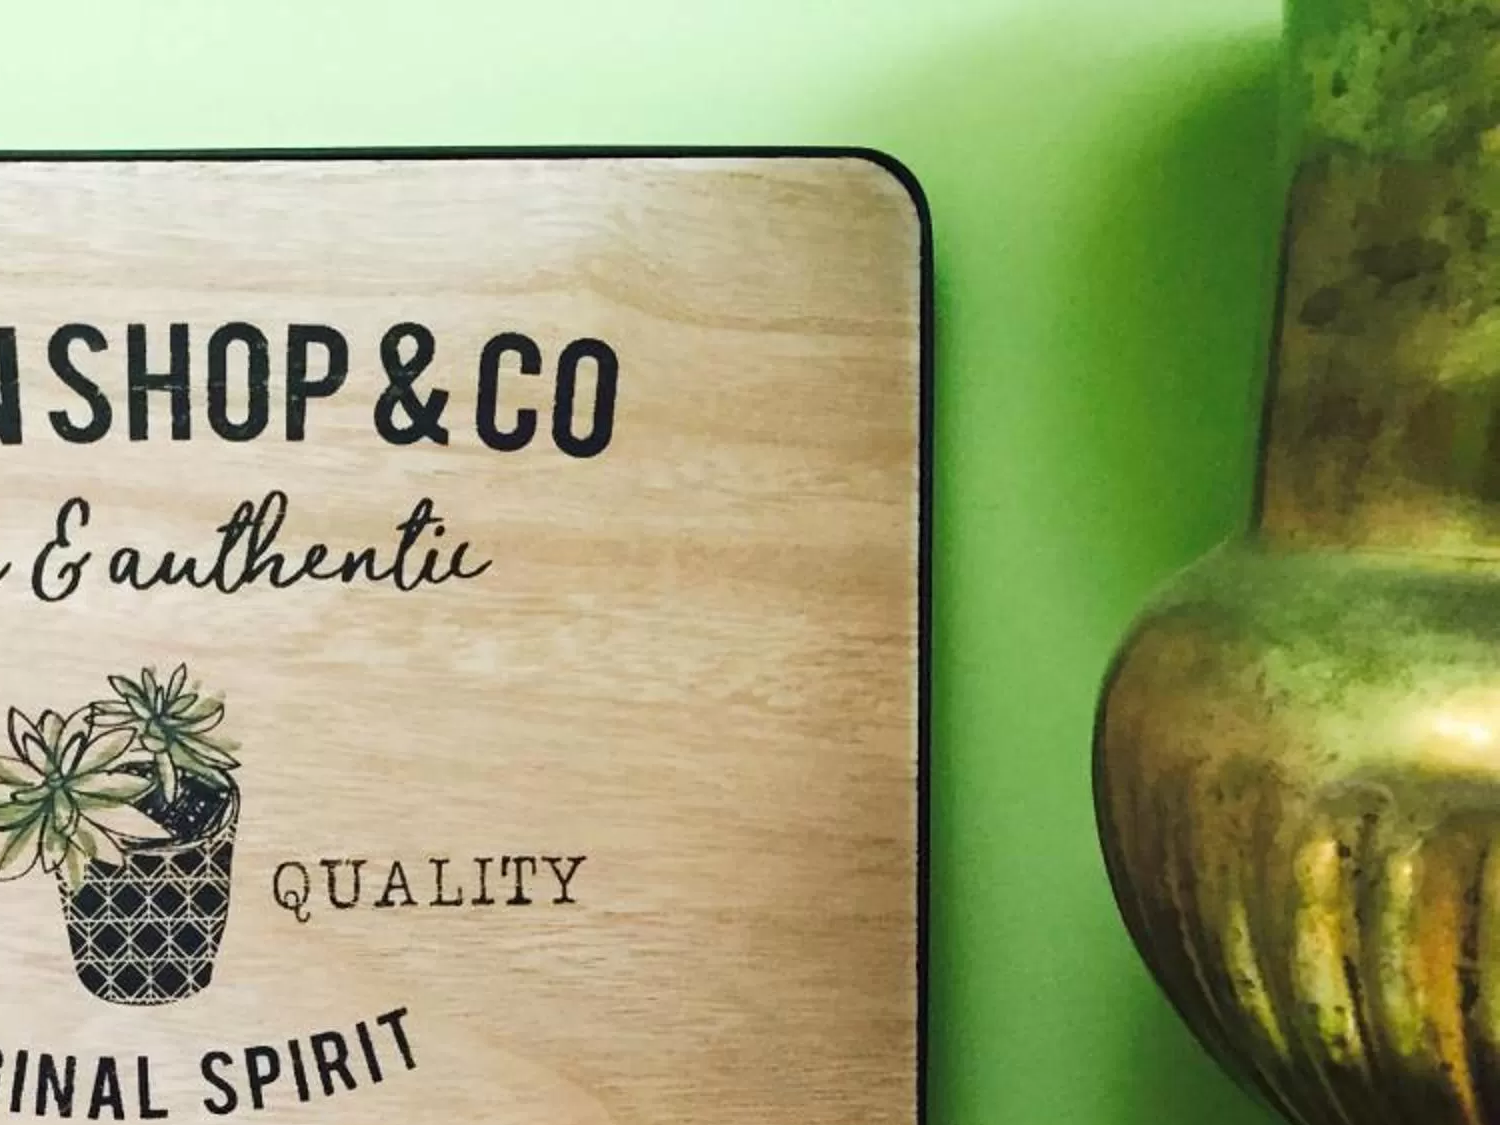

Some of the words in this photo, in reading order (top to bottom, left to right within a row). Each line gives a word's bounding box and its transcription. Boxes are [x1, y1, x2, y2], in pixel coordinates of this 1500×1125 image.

[46, 321, 349, 443] SHOP
[373, 321, 449, 446] &
[474, 330, 620, 458] CO
[31, 496, 92, 602] &
[110, 489, 491, 591] authentic
[272, 854, 587, 923] QUALITY
[201, 1007, 418, 1115] SPIRIT
